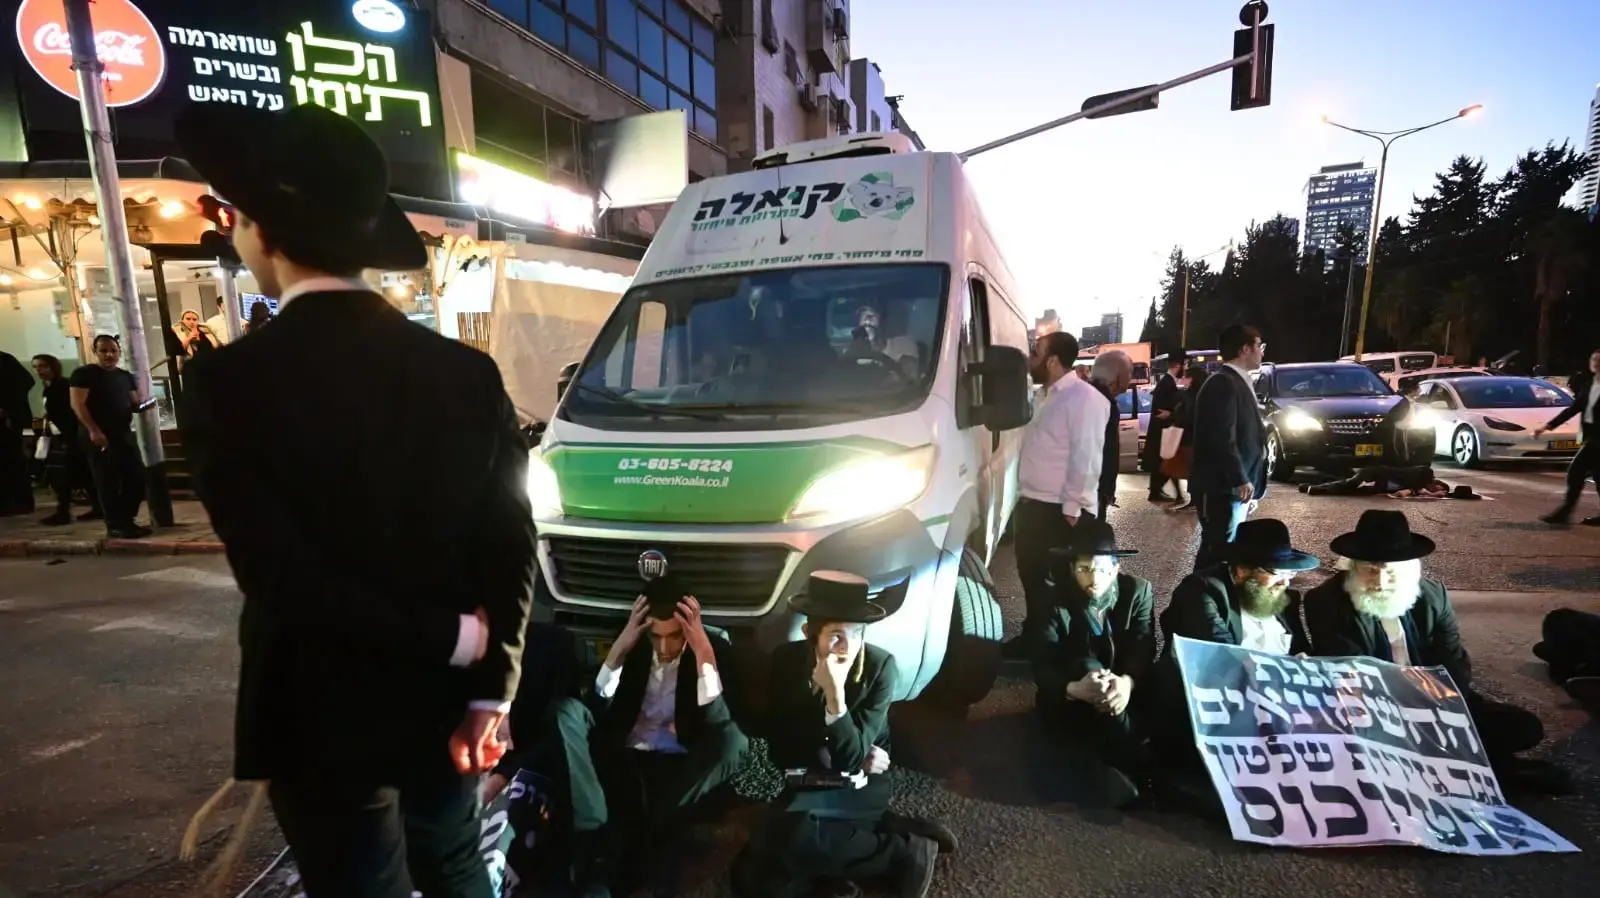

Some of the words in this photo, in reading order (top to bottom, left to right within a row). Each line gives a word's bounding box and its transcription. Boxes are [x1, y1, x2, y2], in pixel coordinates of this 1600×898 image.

[168, 25, 277, 57] שווארמה
[193, 56, 281, 84] ובשרים
[187, 84, 248, 106] האש
[252, 89, 284, 111] על
[693, 182, 845, 221] קואלה
[613, 474, 731, 488] www.GreenKoala.co.il
[644, 559, 661, 574] FIAT
[1191, 684, 1479, 756] החשמונאים
[1204, 735, 1335, 783] שלטון
[1230, 777, 1558, 850] אנטיוכוס
